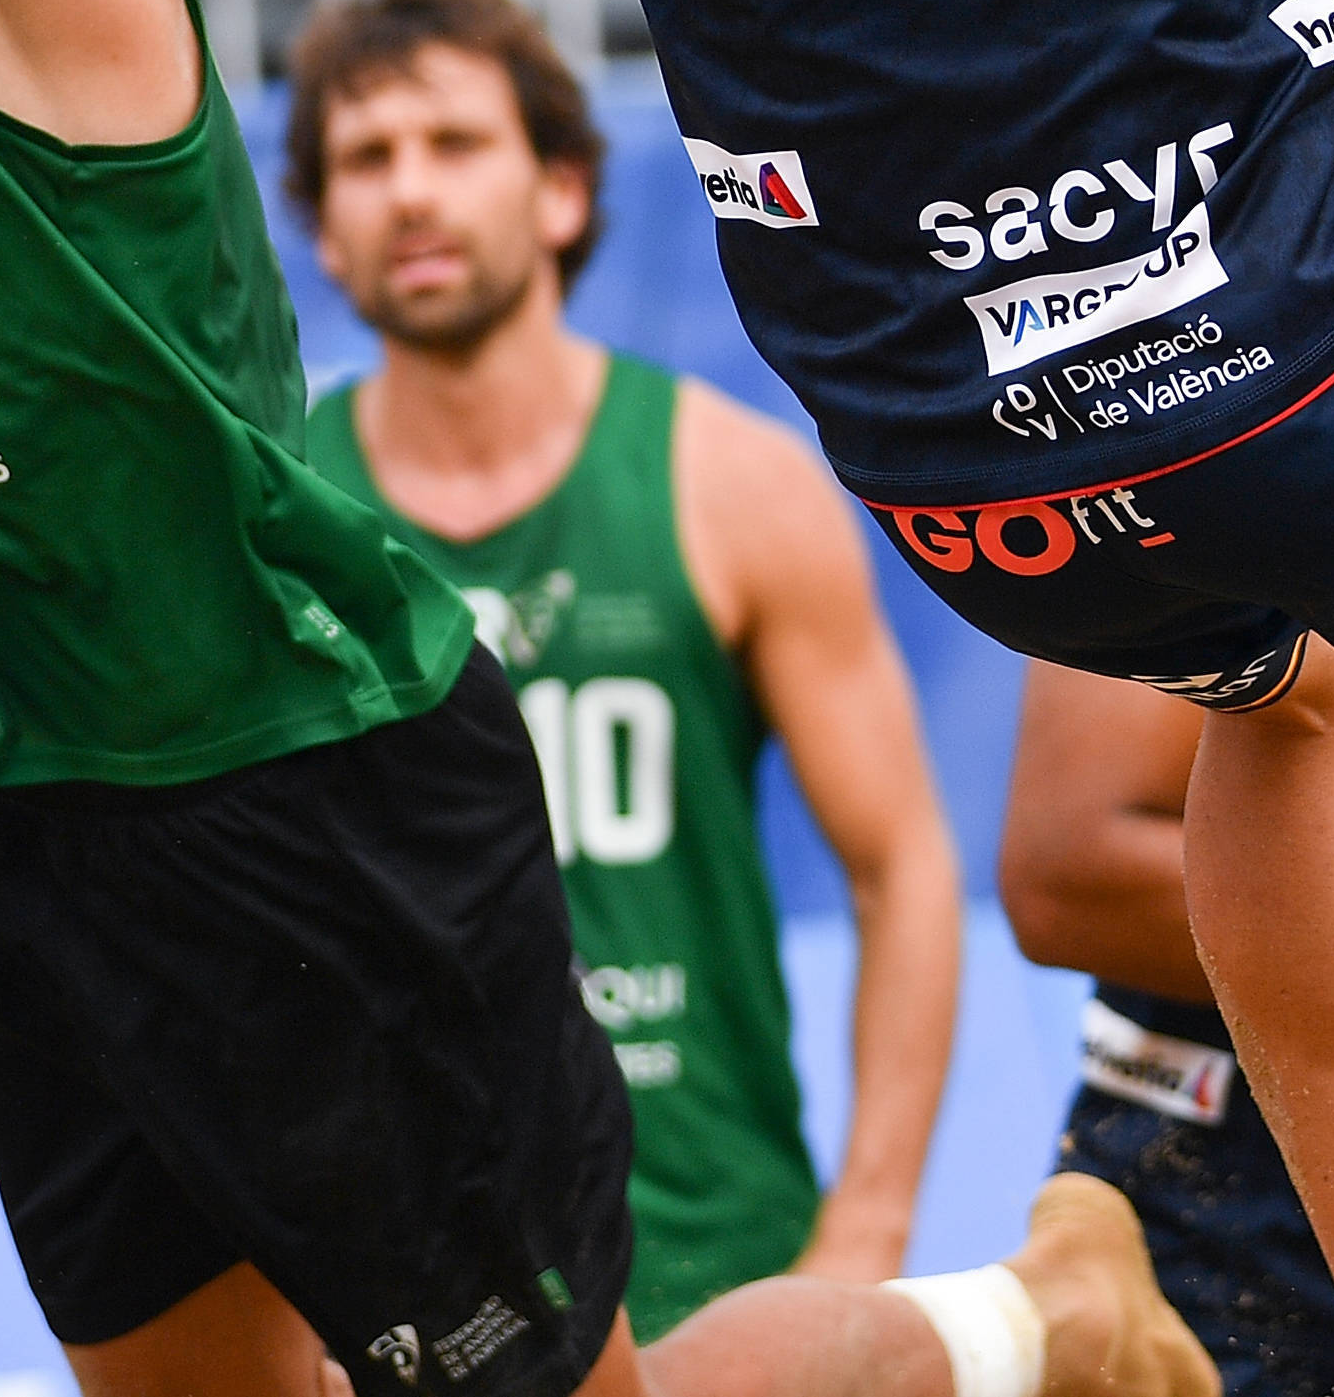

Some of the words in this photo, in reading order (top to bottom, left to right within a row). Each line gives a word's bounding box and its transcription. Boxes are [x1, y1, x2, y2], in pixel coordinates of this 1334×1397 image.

[918, 122, 1235, 271] sacyr
[985, 231, 1200, 347] VARGUP
[1063, 313, 1223, 394] Diputació
[1088, 401, 1130, 430] de
[1126, 345, 1275, 417] València
[519, 676, 675, 867] 10
